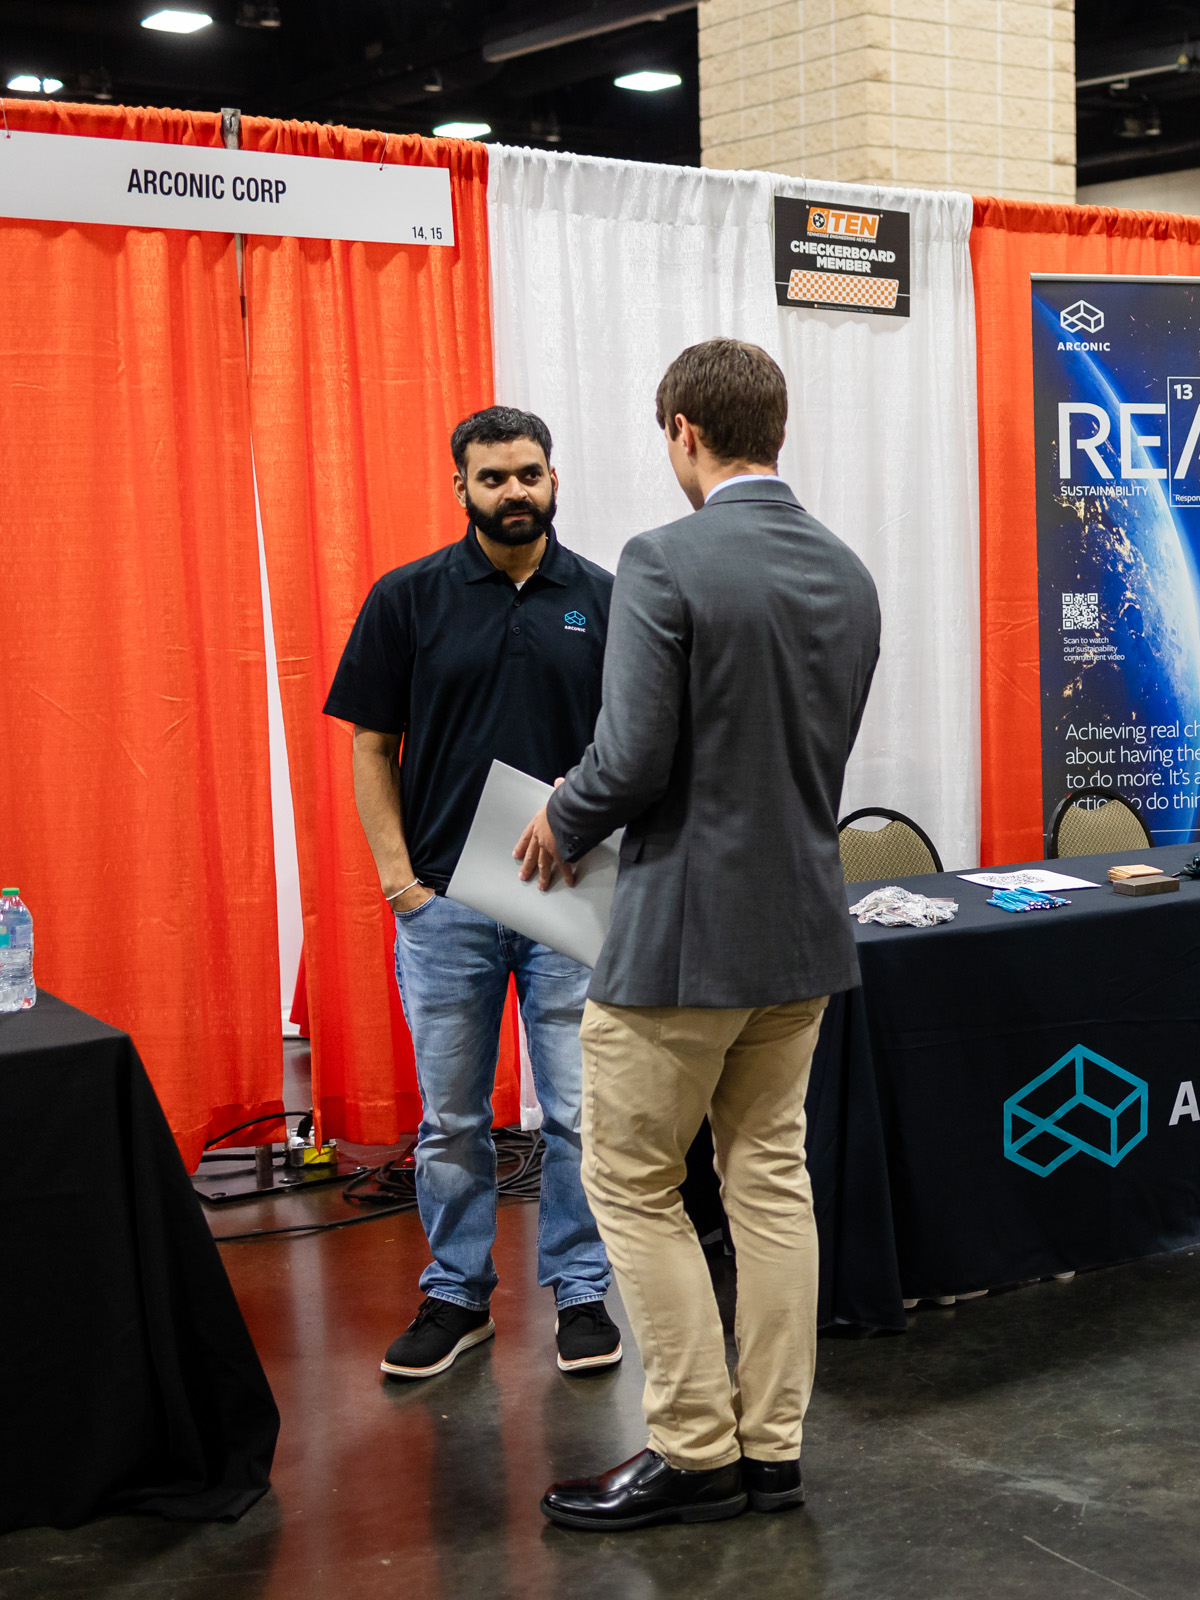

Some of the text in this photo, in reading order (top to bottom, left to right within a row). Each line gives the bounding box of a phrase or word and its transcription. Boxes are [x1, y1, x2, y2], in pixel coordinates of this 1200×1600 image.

[127, 168, 287, 204] ARCONIC CORP
[830, 212, 878, 237] TEN
[412, 226, 443, 241] 14, 15
[790, 240, 896, 263] CHECKERBOARD
[816, 256, 871, 273] MEMBER
[1057, 342, 1111, 352] ARCONIC
[1173, 383, 1193, 400] 13
[1060, 486, 1149, 497] SUSTAINABILITY
[1063, 637, 1080, 645] Scan
[1089, 636, 1110, 644] watch
[1077, 645, 1118, 654] sustainability
[1107, 653, 1125, 661] video
[1065, 723, 1147, 744] Achieving
[1151, 719, 1180, 738] real
[1065, 746, 1116, 765] about
[1120, 745, 1174, 767] having
[1066, 773, 1086, 789] to
[1090, 770, 1113, 788] do
[1118, 772, 1165, 788] more.
[1169, 768, 1190, 785] It’s
[1146, 792, 1169, 810] do
